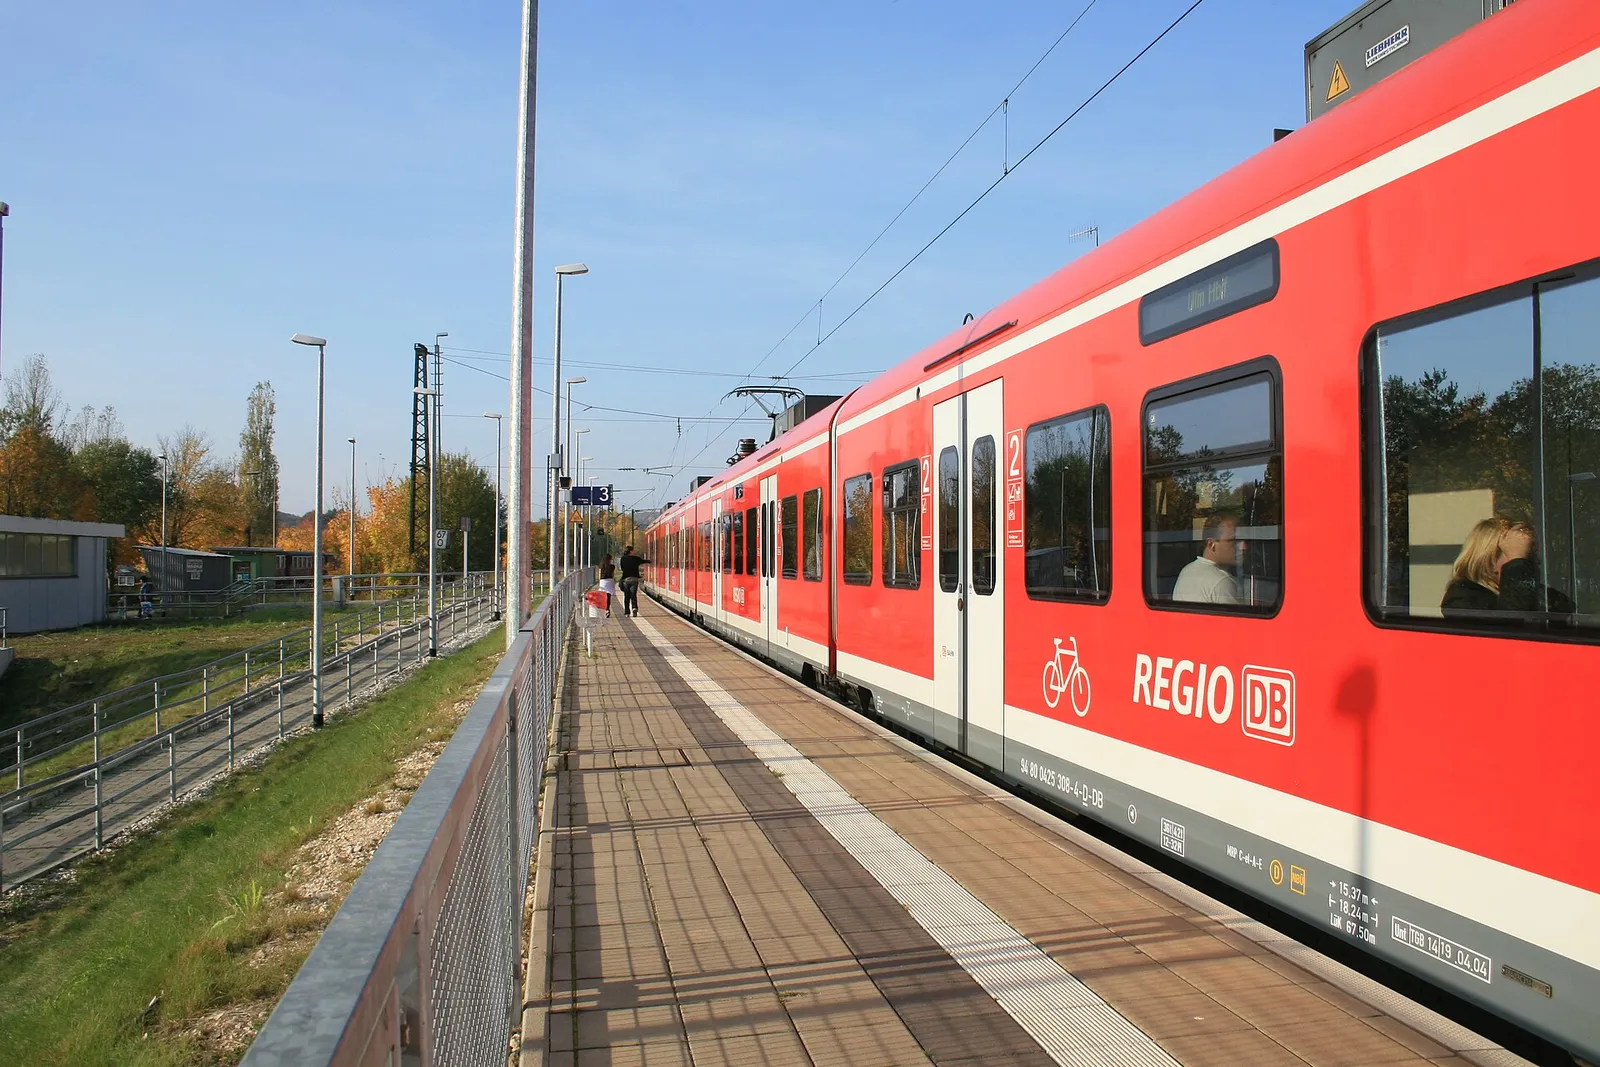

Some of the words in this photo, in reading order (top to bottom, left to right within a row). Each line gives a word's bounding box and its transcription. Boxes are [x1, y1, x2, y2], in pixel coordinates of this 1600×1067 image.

[1367, 27, 1407, 59] LIEBHERR
[1009, 434, 1019, 477] 2
[923, 459, 930, 493] 2
[599, 487, 609, 502] 3
[1133, 653, 1234, 724] REGIO
[1247, 675, 1290, 735] DB
[1020, 758, 1028, 775] 94
[1029, 761, 1038, 779] 80
[1039, 766, 1055, 787] 0425
[1057, 773, 1103, 809] 308-4-D-DB
[1346, 920, 1376, 945] 67.50m
[1394, 922, 1407, 941] Unt
[1410, 928, 1425, 948] TGB
[1427, 936, 1438, 954] 14
